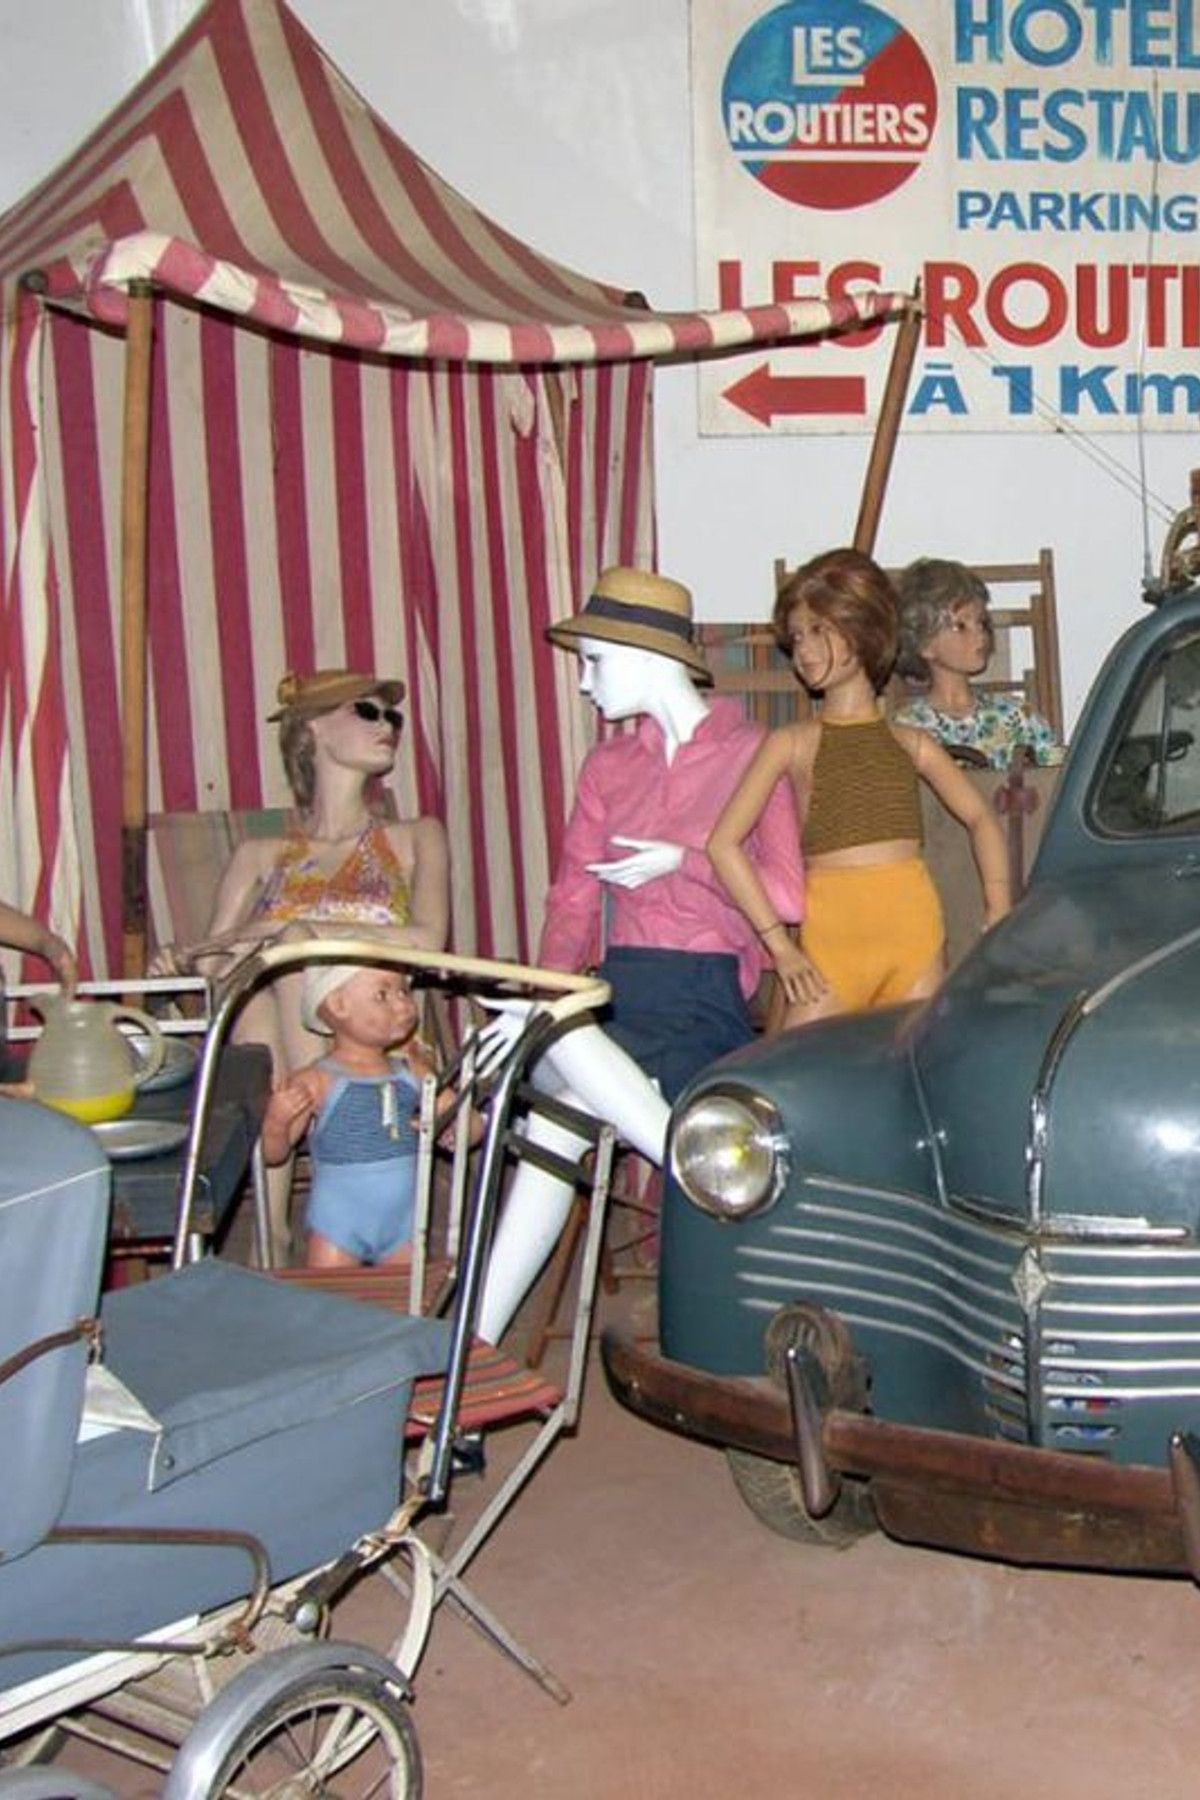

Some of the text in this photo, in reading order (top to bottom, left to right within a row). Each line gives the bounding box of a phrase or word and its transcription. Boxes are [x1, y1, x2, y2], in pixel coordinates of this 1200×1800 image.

[792, 26, 865, 87] LES
[729, 101, 930, 145] ROUTIERS
[957, 190, 1197, 232] PARKING
[992, 366, 1034, 415] 1
